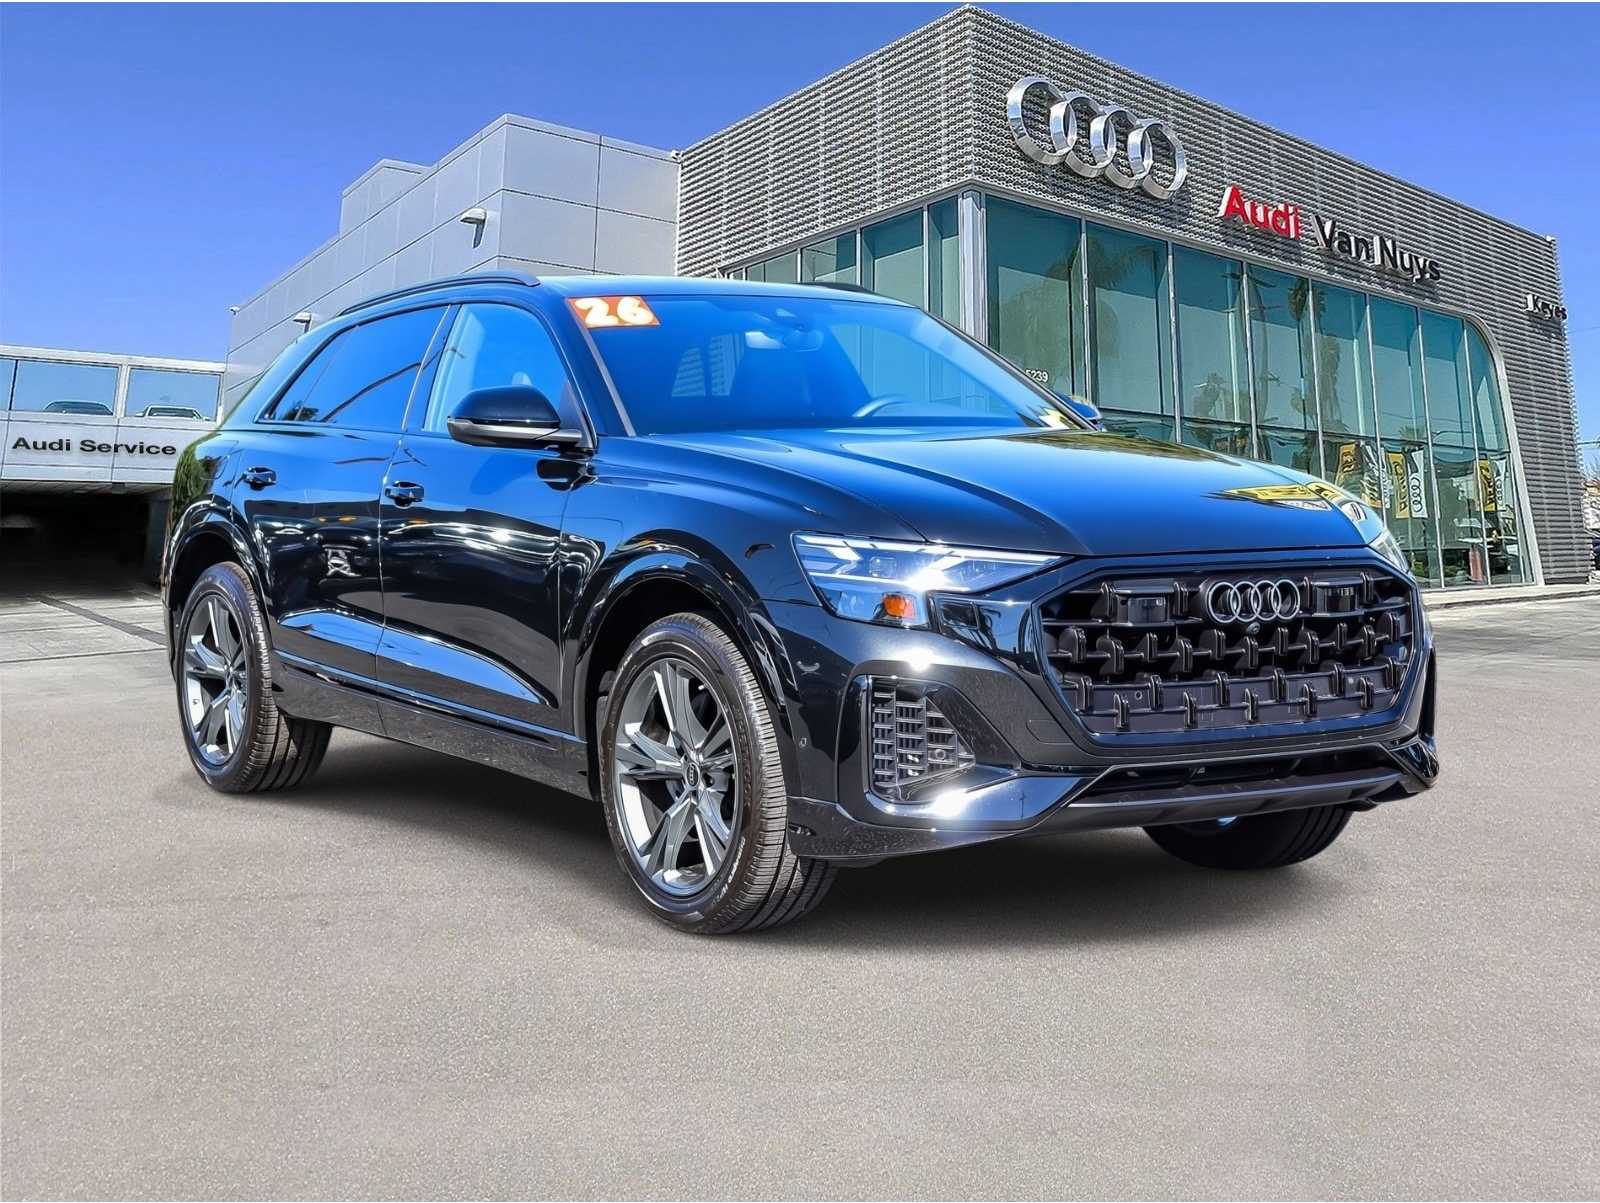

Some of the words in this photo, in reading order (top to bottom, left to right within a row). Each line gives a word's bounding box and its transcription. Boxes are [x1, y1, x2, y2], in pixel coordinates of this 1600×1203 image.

[1218, 184, 1302, 241] Audi
[1311, 214, 1374, 262] Van
[1375, 235, 1441, 283] Nuys
[574, 296, 655, 327] 26
[1527, 293, 1568, 320] Keyes
[12, 437, 71, 452] Audi
[80, 439, 177, 455] Service
